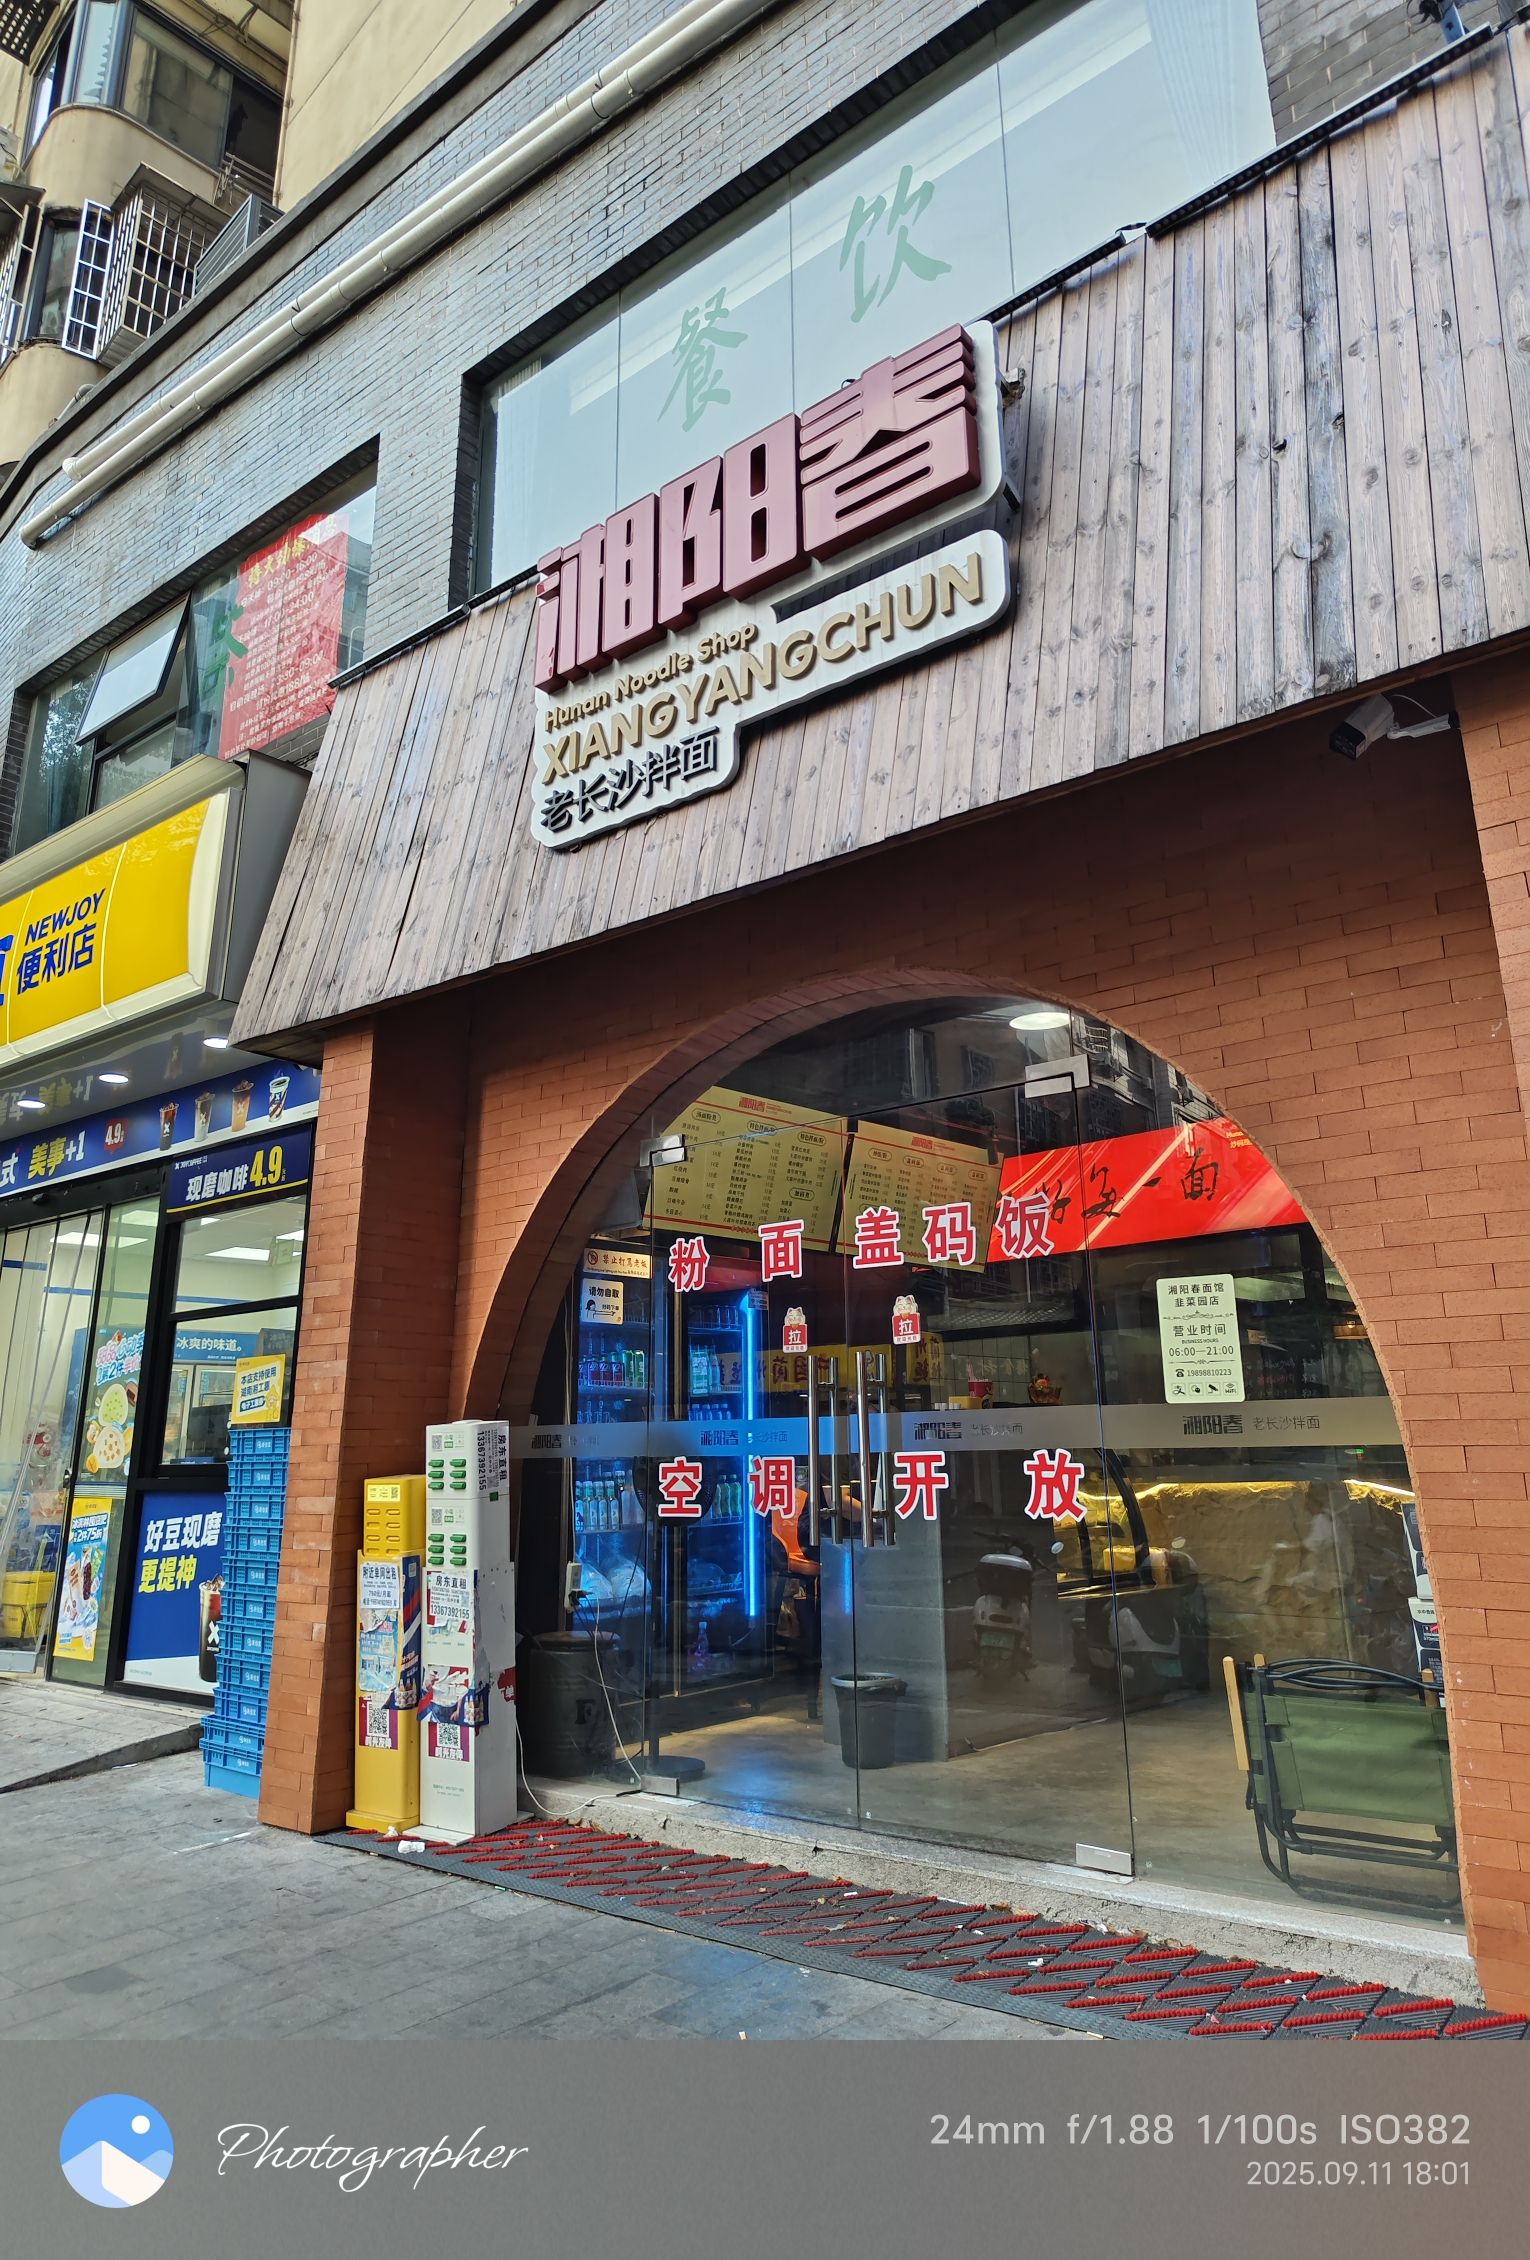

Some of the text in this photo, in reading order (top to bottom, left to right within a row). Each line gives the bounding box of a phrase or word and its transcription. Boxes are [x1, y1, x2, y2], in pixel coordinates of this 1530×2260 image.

[658, 165, 952, 432] 餐饮
[542, 551, 983, 785] XIANGYANGCHUN
[544, 621, 758, 732] Hunan Noodle Shop
[540, 726, 720, 832] 老长沙拌面
[25, 888, 106, 946] NEWJOY
[16, 923, 97, 995] 便利店
[186, 1145, 283, 1202] 现磨咖啡 4.9
[669, 1191, 1055, 1292] 粉面盖码饭
[589, 1286, 620, 1299] 请勿自取
[1168, 1282, 1225, 1295] 湘阳春面馆
[1175, 1296, 1220, 1308] 韭菜园店
[176, 1336, 242, 1352] 冰爽的味道。
[788, 1329, 802, 1345] 拉
[898, 1319, 914, 1336] 拉
[1173, 1324, 1226, 1337] 营业时间
[1187, 1368, 1232, 1377] 19898810223
[1182, 1414, 1321, 1436] 湘阳春 老长沙拌面
[476, 1430, 487, 1491] 13367392155
[498, 1434, 508, 1481] 房东直租
[658, 1448, 1087, 1522] 空调开放
[143, 1511, 222, 1553] 好豆现磨
[138, 1554, 198, 1593] 更提神
[436, 1575, 467, 1590] 房东直租
[430, 1604, 470, 1620] 13367392155
